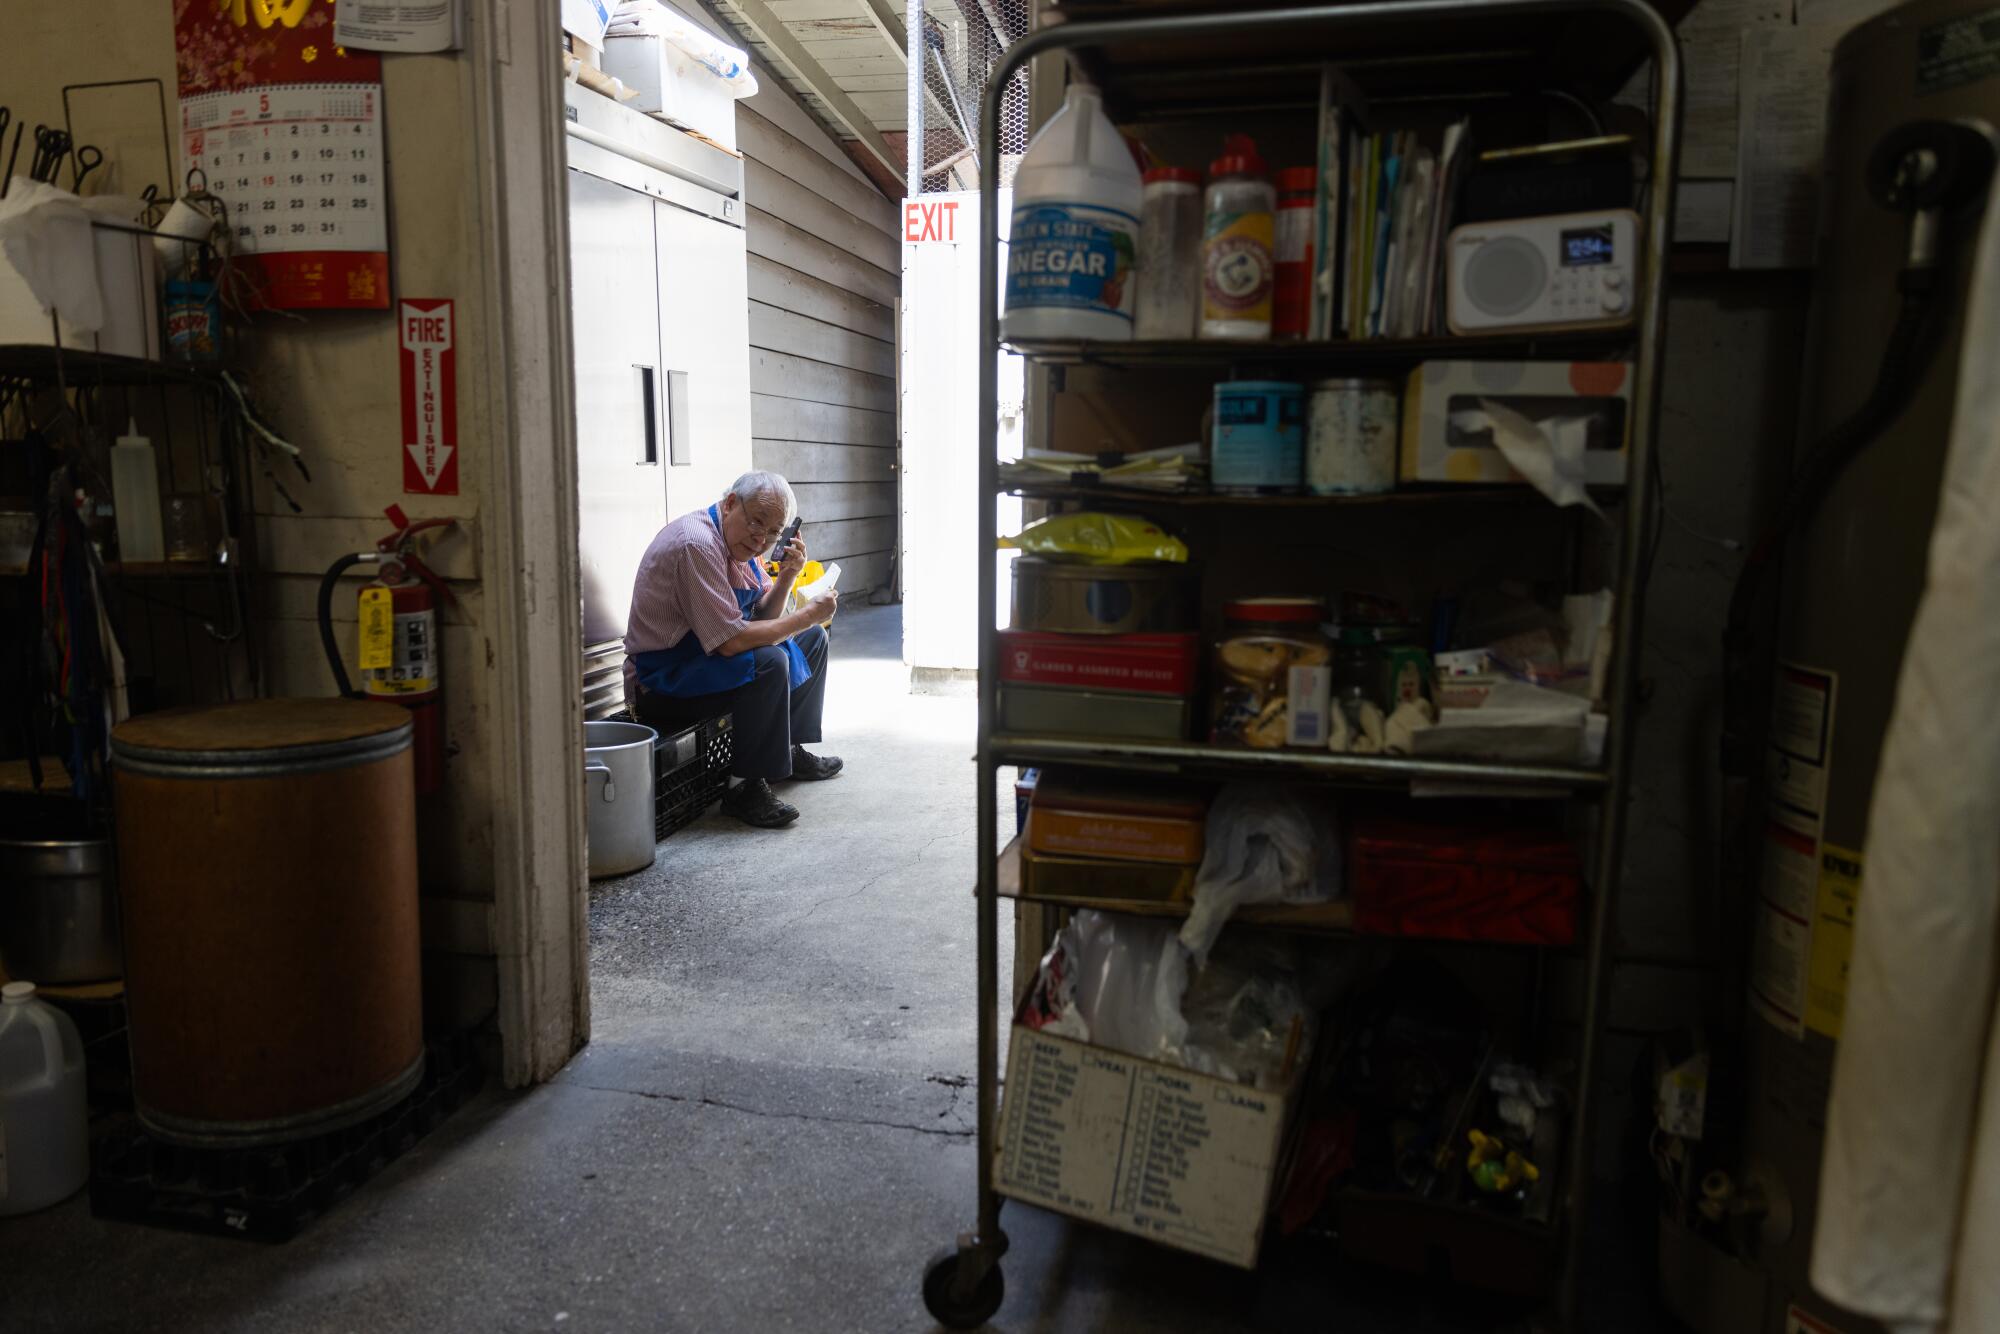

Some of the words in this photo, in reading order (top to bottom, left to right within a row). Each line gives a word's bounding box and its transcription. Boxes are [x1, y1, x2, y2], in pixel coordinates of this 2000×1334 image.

[260, 94, 269, 113] 5
[291, 126, 298, 135] 2
[321, 125, 329, 134] 3
[353, 125, 361, 134] 4
[214, 157, 220, 166] 6
[239, 154, 245, 163] 7
[263, 152, 271, 161] 8
[291, 151, 299, 159] 9
[319, 150, 334, 158] 10
[352, 150, 365, 158] 11
[213, 181, 225, 190] 13
[237, 178, 248, 187] 14
[262, 176, 275, 185] 15
[290, 175, 303, 184] 16
[320, 174, 334, 183] 17
[352, 175, 366, 183] 18
[238, 203, 249, 211] 21
[262, 201, 275, 210] 22
[290, 200, 304, 208] 23
[320, 199, 335, 207] 24
[352, 199, 367, 208] 25
[239, 227, 250, 235] 28
[263, 225, 276, 234] 29
[291, 224, 305, 233] 30
[321, 223, 335, 232] 31
[906, 202, 958, 241] EXIT
[408, 317, 446, 342] FIRE
[423, 348, 436, 476] EXTINGUISHER
[1032, 660, 1074, 674] GARDEN
[1077, 665, 1130, 679] ASSORTED
[1035, 1042, 1060, 1057] BEEF
[1096, 1059, 1126, 1074] VEAL
[1156, 1074, 1191, 1092] PORK
[1229, 1094, 1266, 1112] LAMB
